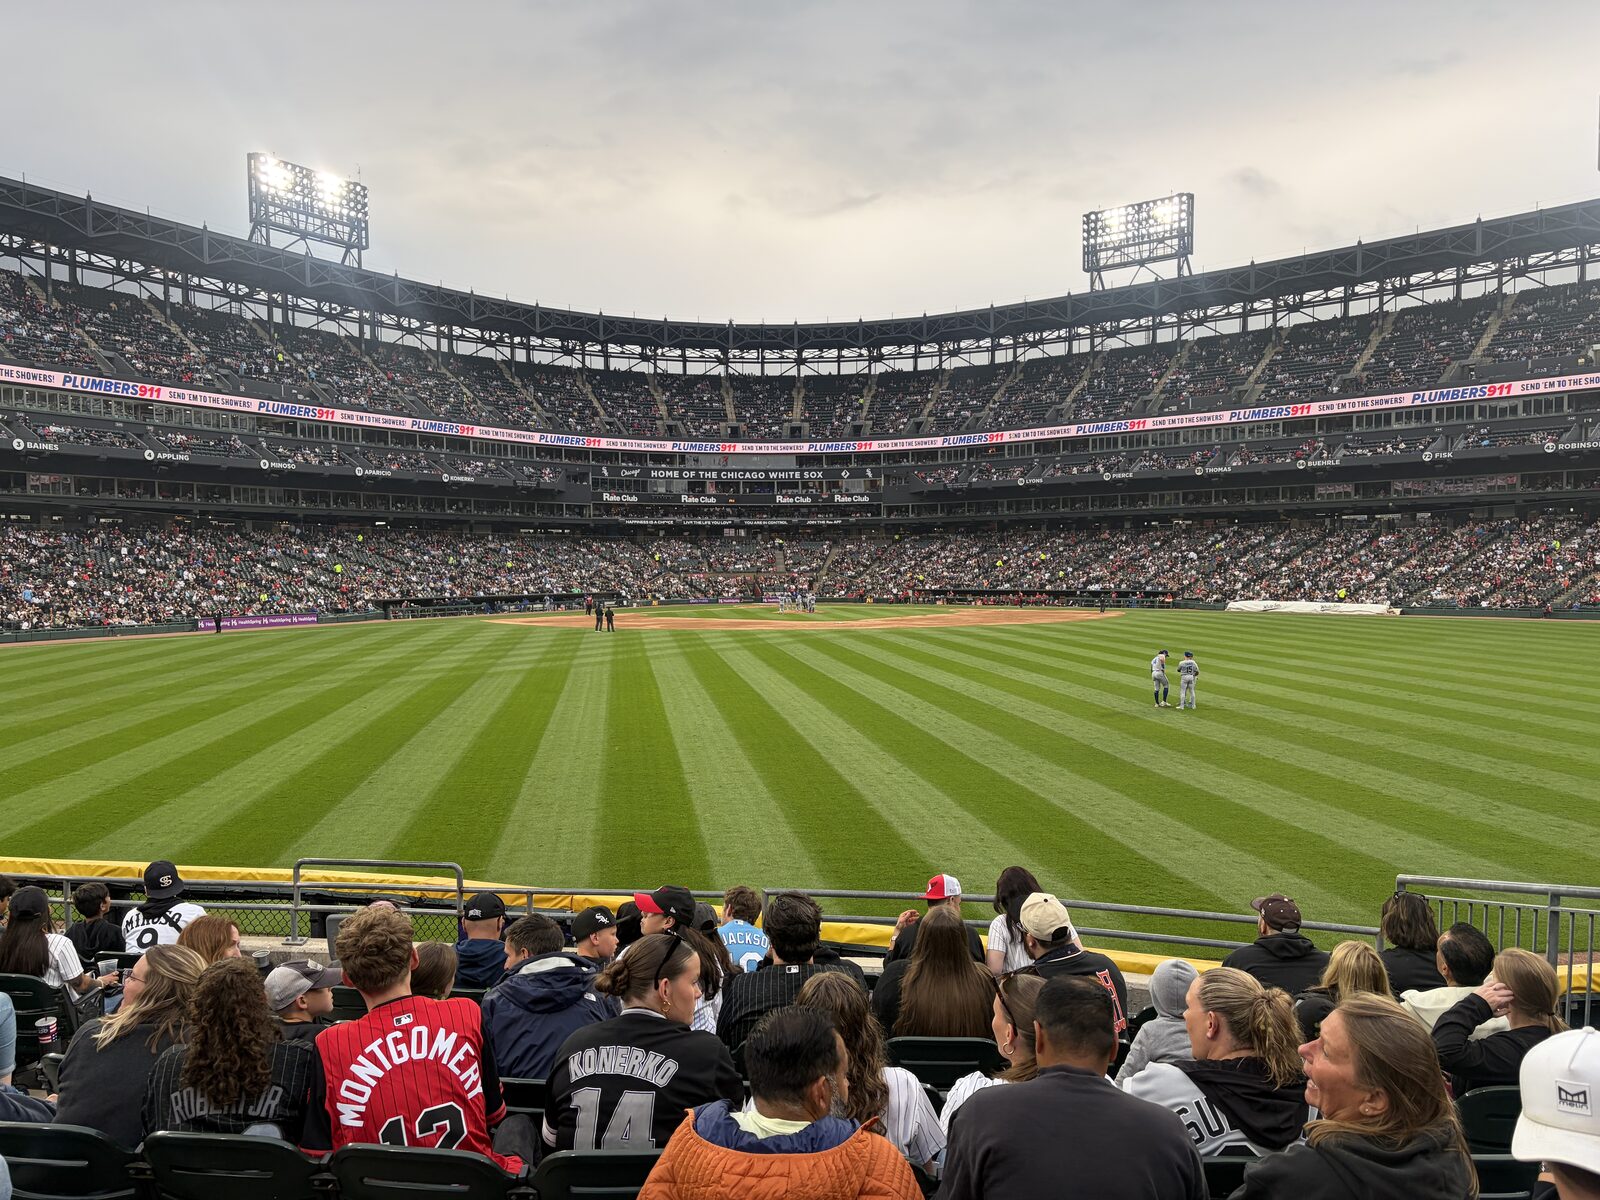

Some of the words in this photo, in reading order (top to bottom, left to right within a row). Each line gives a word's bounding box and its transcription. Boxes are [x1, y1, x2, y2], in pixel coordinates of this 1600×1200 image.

[16, 371, 55, 383] SHOWERS!
[62, 375, 162, 398] PLUMBERS911
[169, 391, 185, 400] SEND
[208, 396, 220, 404] THE
[221, 397, 252, 408] SHOWERS!
[1411, 384, 1512, 404] PLUMBERS911
[1371, 397, 1404, 406] SHOWERS!
[258, 401, 335, 420] PLUMBERS911
[1229, 405, 1311, 421] PLUMBERS911
[371, 415, 381, 423] THE
[382, 416, 406, 426] SHOWERS!
[1196, 414, 1224, 422] SHOWERS!
[411, 420, 474, 435] PLUMBERS911
[1076, 420, 1146, 434] PLUMBERS911
[539, 434, 601, 447] PLUMBERS911
[942, 433, 1004, 445] PLUMBERS911
[26, 442, 59, 451] BAINES
[672, 443, 736, 452] PLUMBERS911
[808, 442, 872, 451] PLUMBERS911
[1558, 442, 1600, 450] ROBINSO
[156, 453, 190, 461] APPLING
[603, 493, 620, 501] Rate
[722, 932, 769, 949] JACKSO
[568, 1046, 679, 1088] KONERKO
[336, 1026, 483, 1127] MONTGOMERY
[248, 1085, 283, 1118] JR
[570, 1087, 655, 1150] 14
